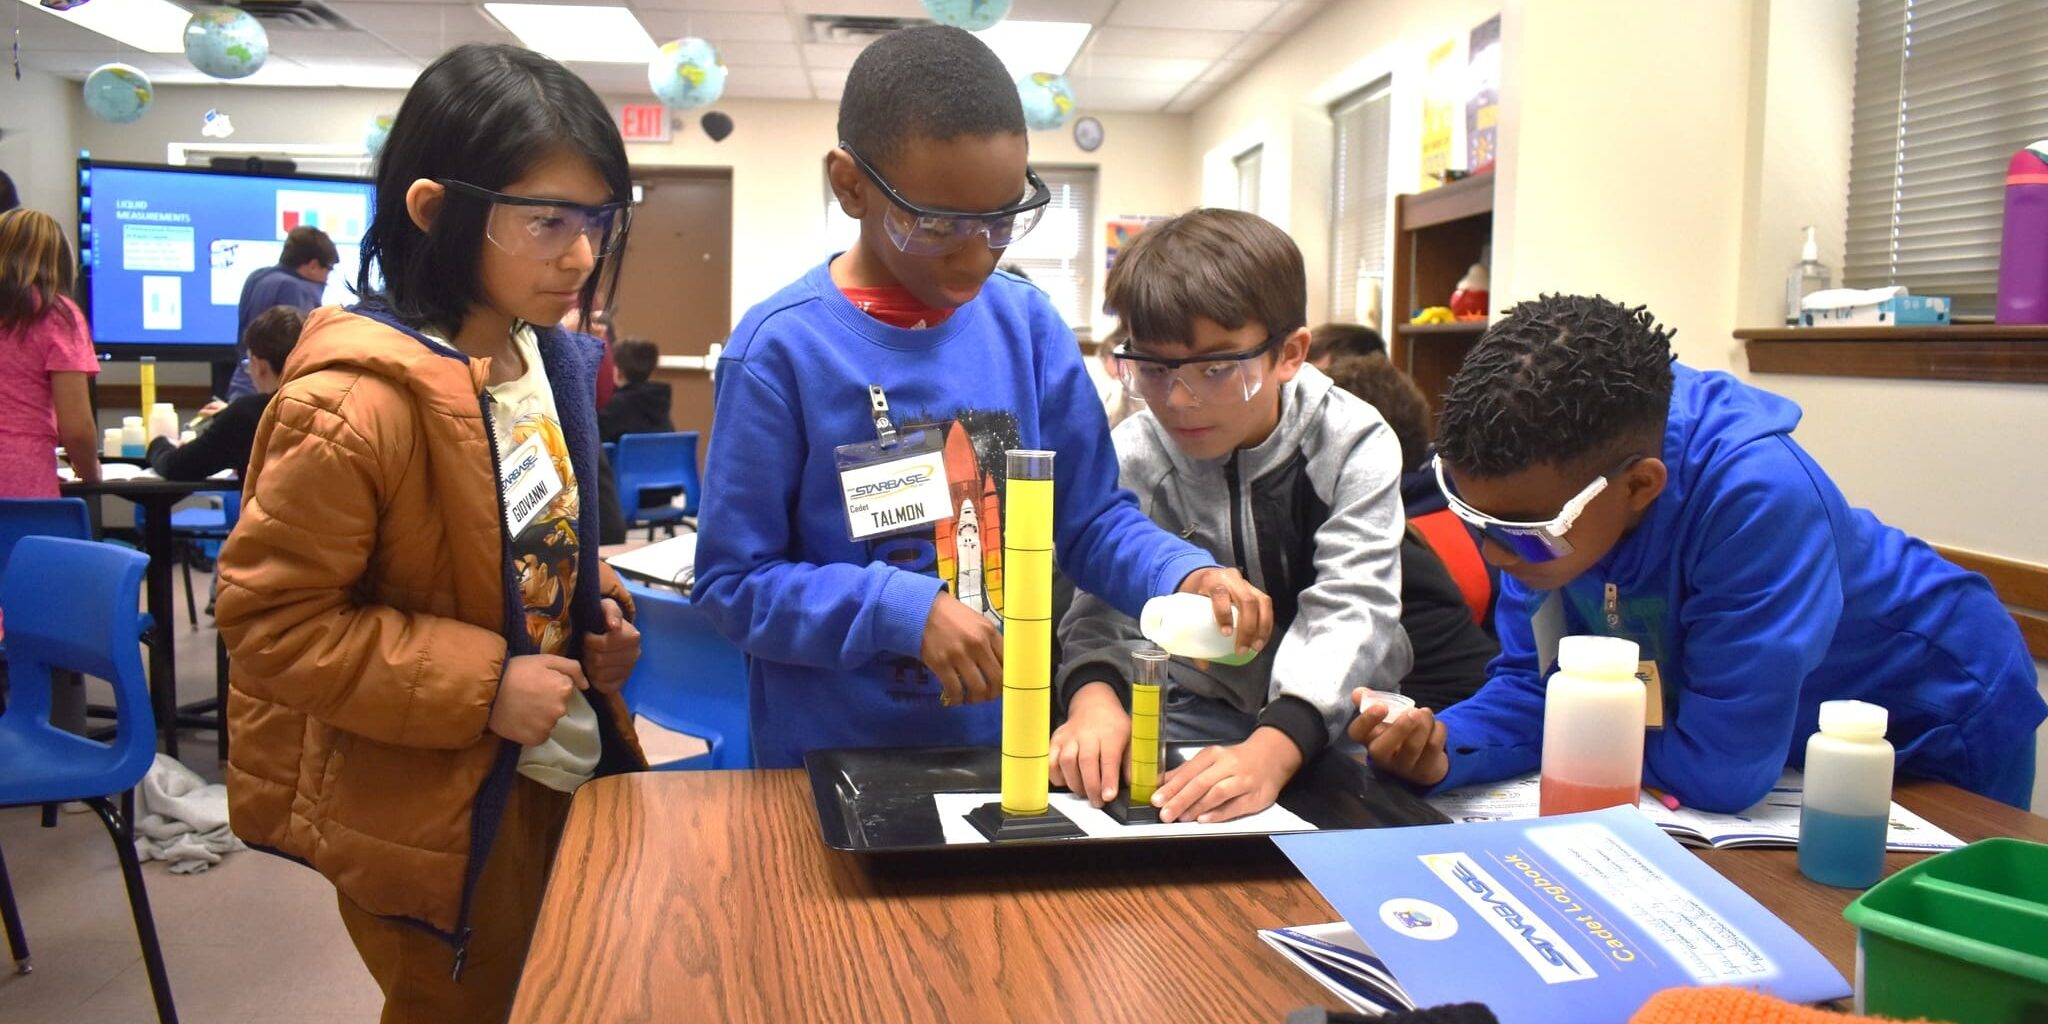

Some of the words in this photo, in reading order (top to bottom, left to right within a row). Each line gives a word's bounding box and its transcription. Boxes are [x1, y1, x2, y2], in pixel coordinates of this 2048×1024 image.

[623, 105, 663, 137] EXIT
[116, 200, 148, 210] LIQUID
[116, 210, 191, 222] MEASUREMENTS
[502, 454, 538, 490] ARBASE
[850, 473, 930, 498] STARBASE
[512, 480, 549, 523] GIOVANNI
[849, 503, 870, 514] Cadet
[871, 502, 925, 528] TALMON
[1504, 853, 1583, 914] Logbook
[1452, 860, 1582, 976] STARBASE
[1576, 911, 1636, 962] Cadet
